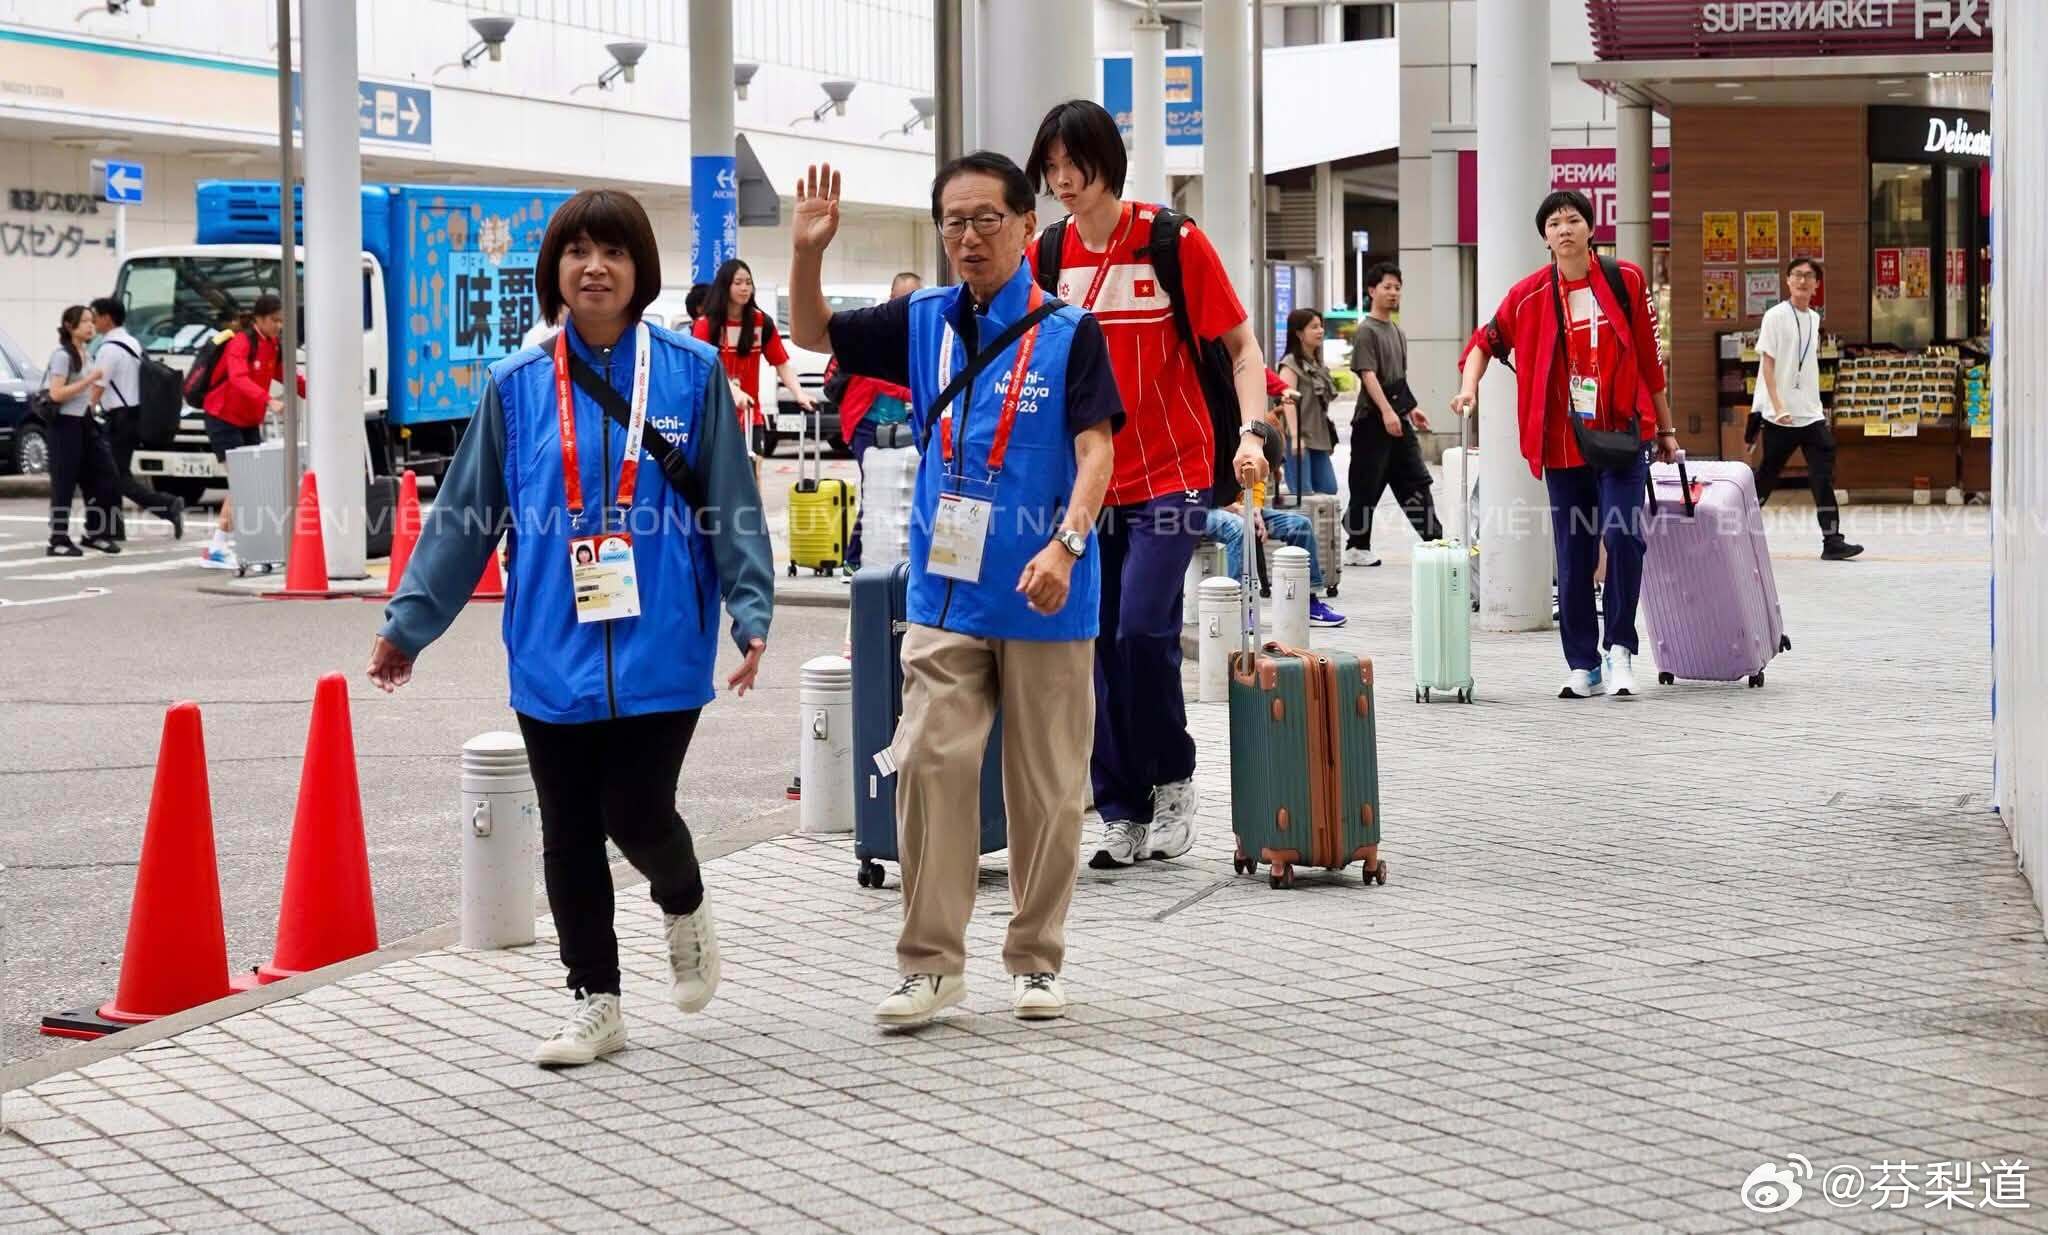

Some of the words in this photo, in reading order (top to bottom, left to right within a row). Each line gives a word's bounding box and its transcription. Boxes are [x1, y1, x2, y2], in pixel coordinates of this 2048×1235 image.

[1702, 0, 1895, 32] SUPERMARKET
[1002, 371, 1046, 385] Ahi-
[994, 382, 1051, 400] Noya
[646, 415, 686, 430] ichi-
